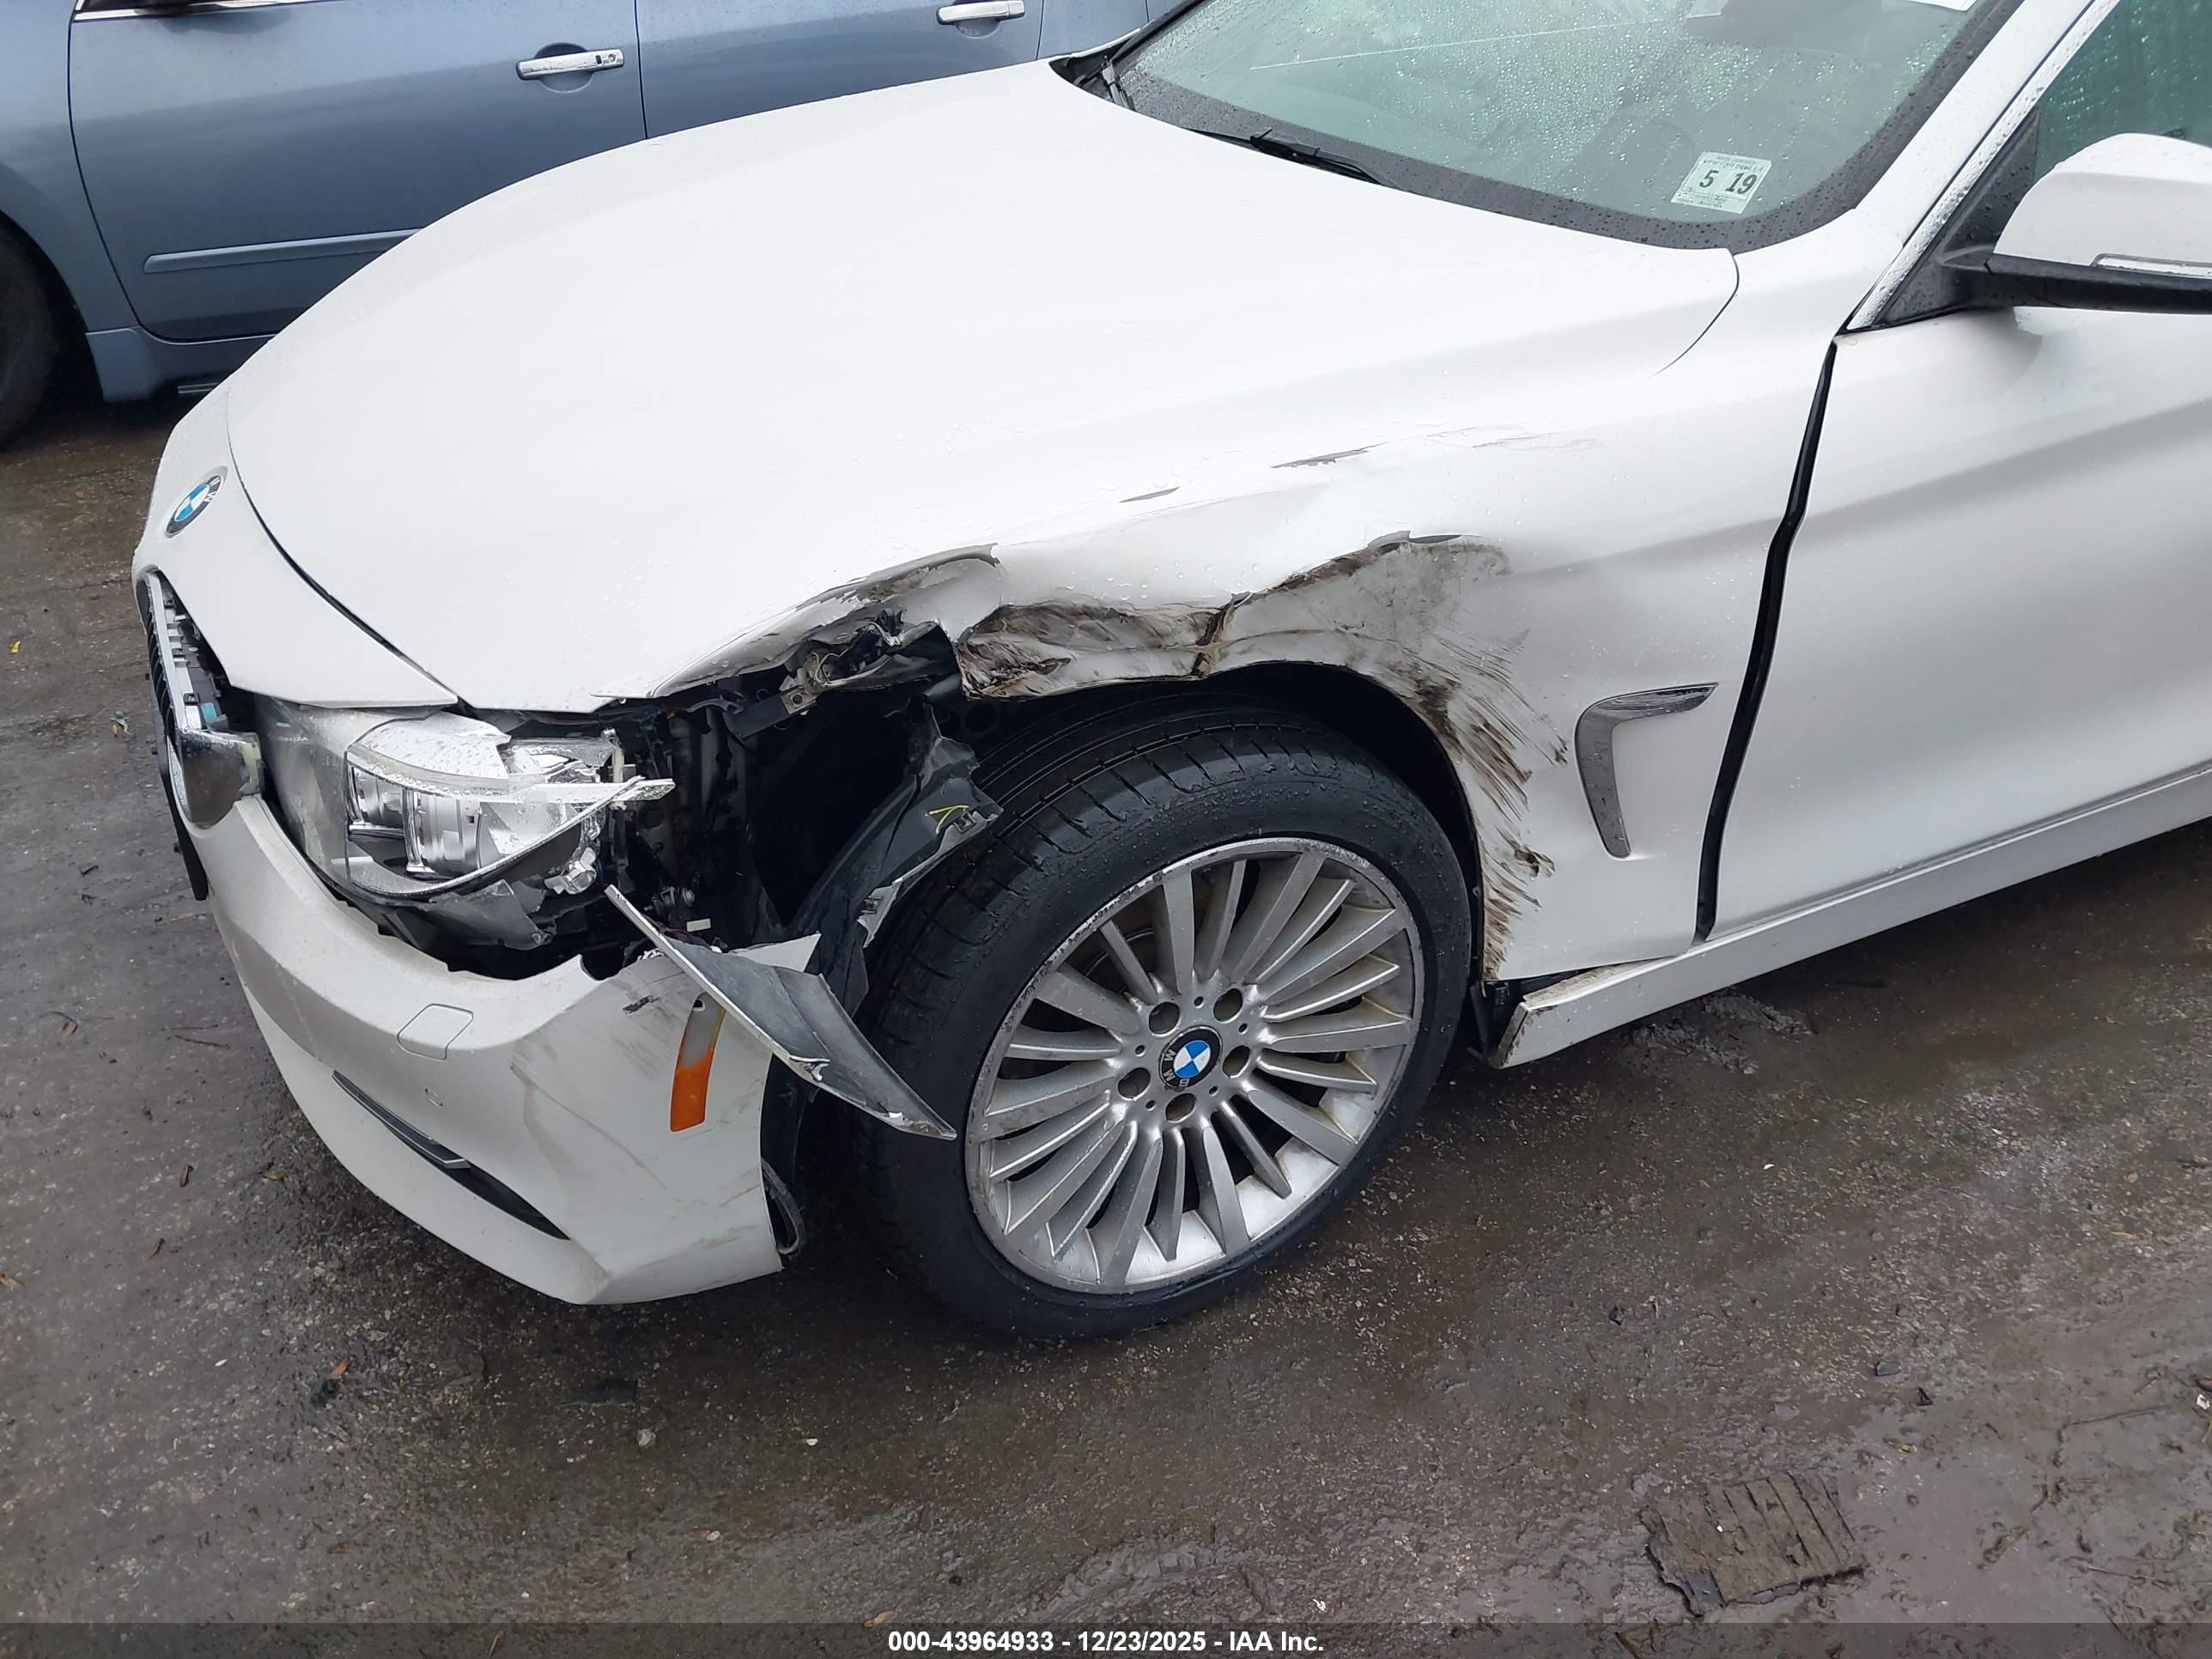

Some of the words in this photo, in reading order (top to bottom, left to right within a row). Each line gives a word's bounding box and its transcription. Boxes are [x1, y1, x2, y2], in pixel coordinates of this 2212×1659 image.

[1699, 169, 1719, 188] 5
[1724, 173, 1758, 194] 19
[1164, 1048, 1190, 1087] BMW
